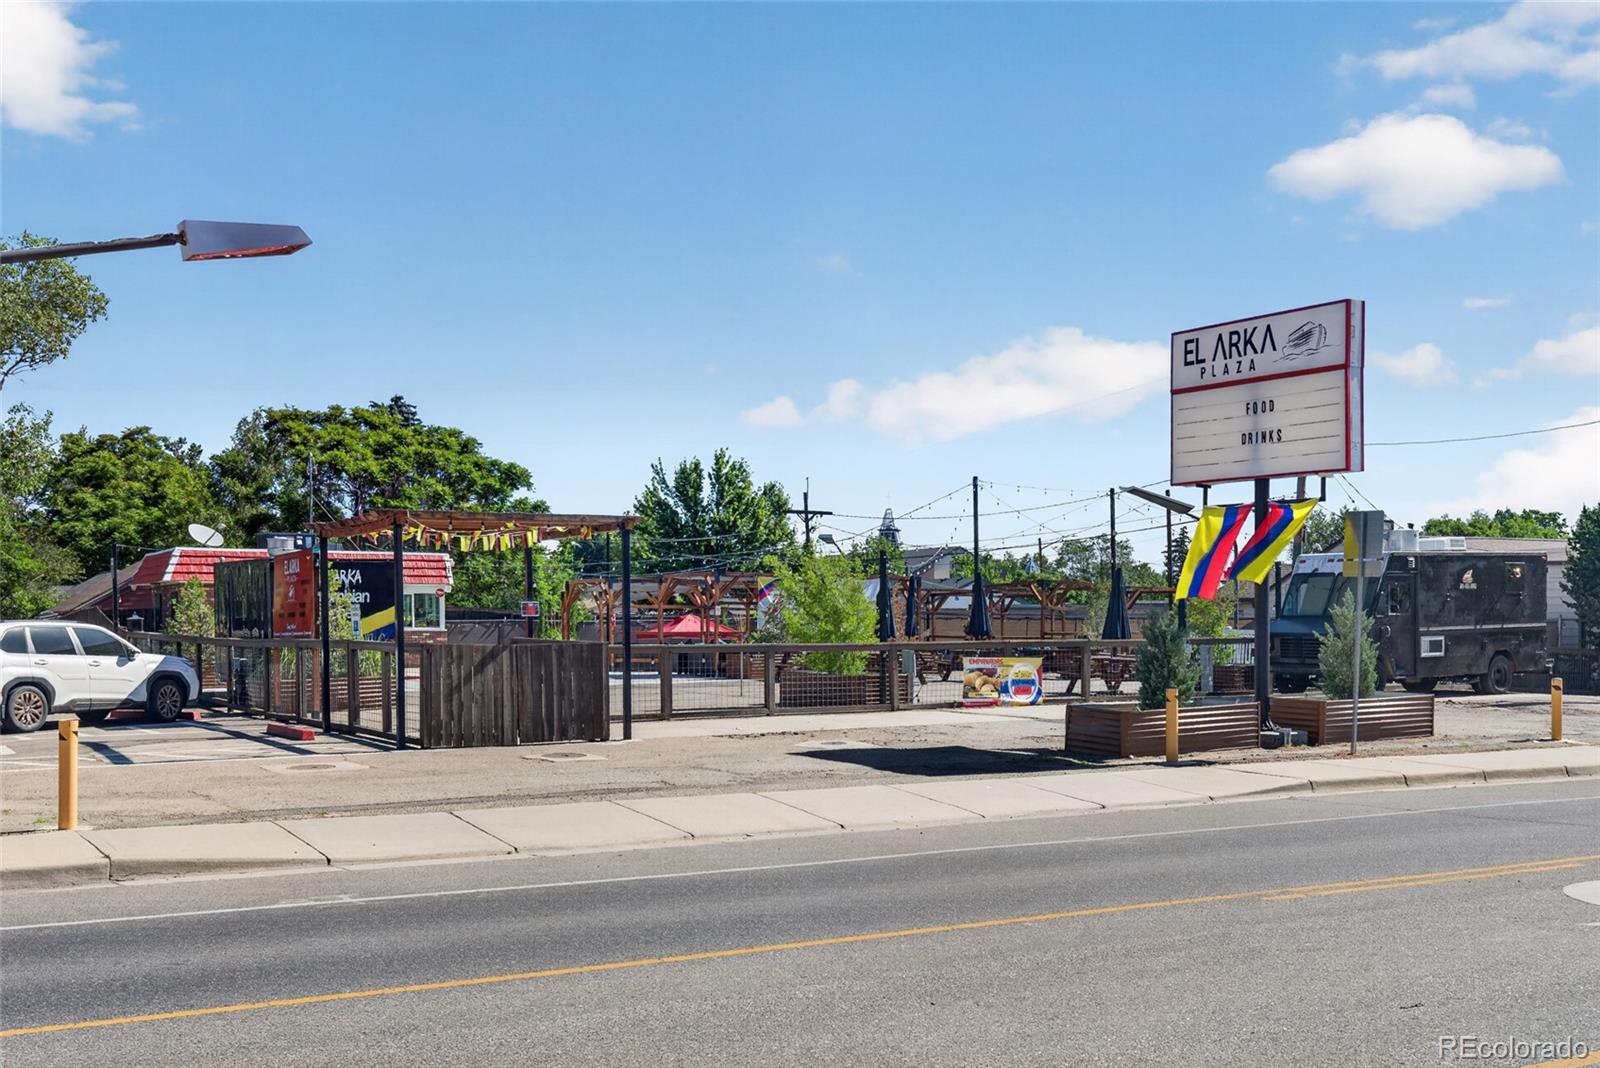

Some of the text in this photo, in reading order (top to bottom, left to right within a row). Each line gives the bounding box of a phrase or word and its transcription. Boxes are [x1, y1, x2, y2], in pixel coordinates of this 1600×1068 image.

[1183, 324, 1277, 367] EL ARKA
[1200, 358, 1256, 380] PLAZA
[1245, 400, 1275, 416] FOOD
[1241, 429, 1283, 446] DRINKS
